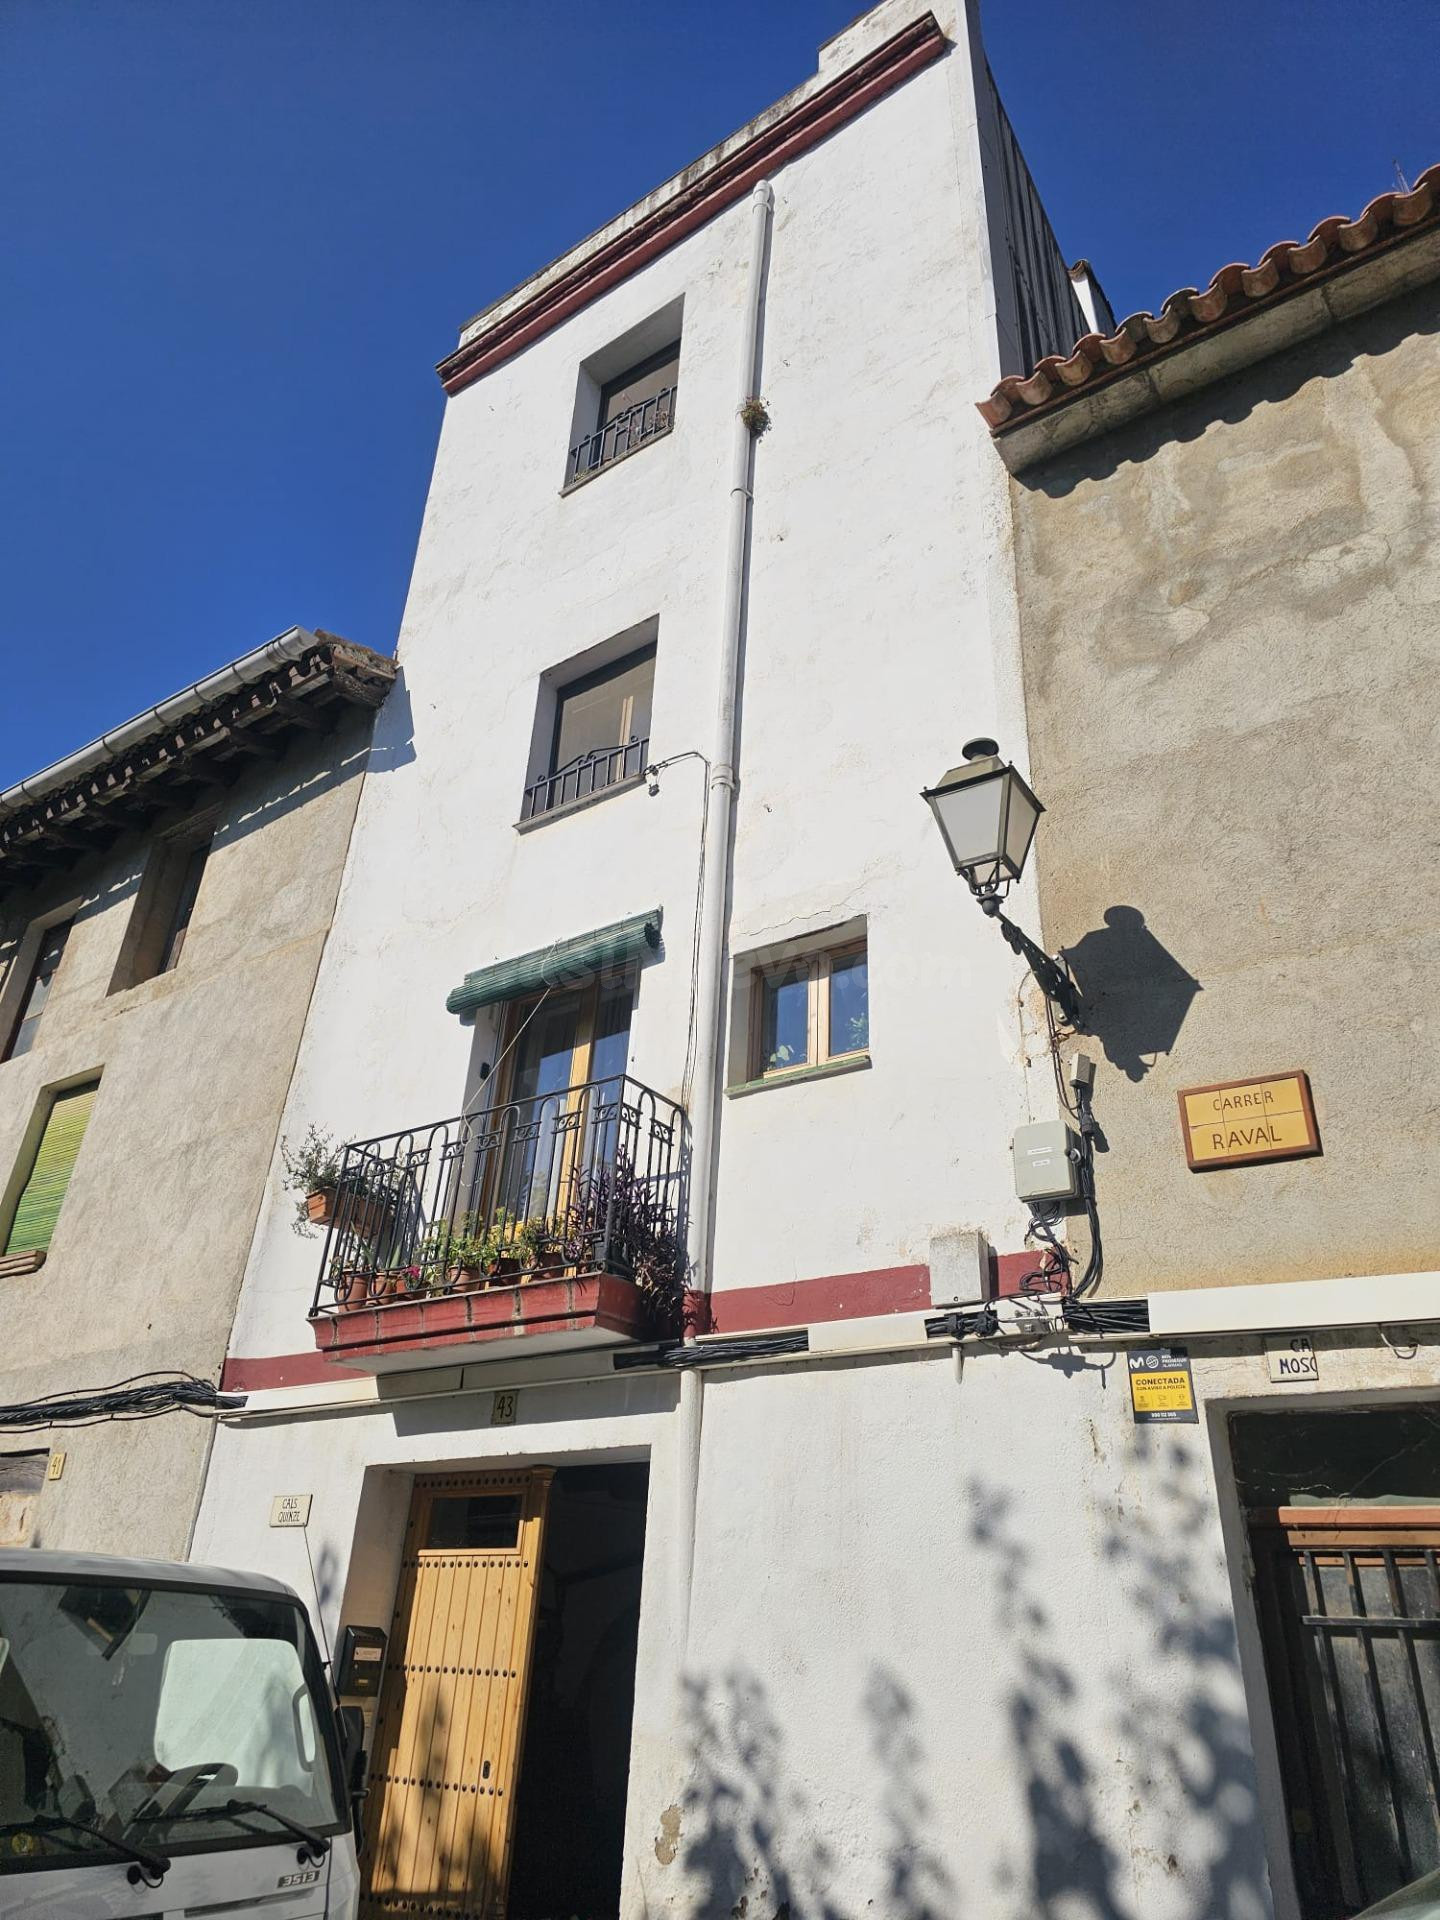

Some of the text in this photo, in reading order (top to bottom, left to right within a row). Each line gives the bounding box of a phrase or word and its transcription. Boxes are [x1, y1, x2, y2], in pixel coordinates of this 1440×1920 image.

[1213, 1091, 1274, 1111] CARRER
[1212, 1126, 1282, 1150] RAVAL
[1290, 1338, 1311, 1353] CA
[1135, 1377, 1185, 1386] CONECTADA
[496, 1395, 514, 1419] 43
[282, 1498, 298, 1509] CALS
[283, 1872, 316, 1887] 3513
